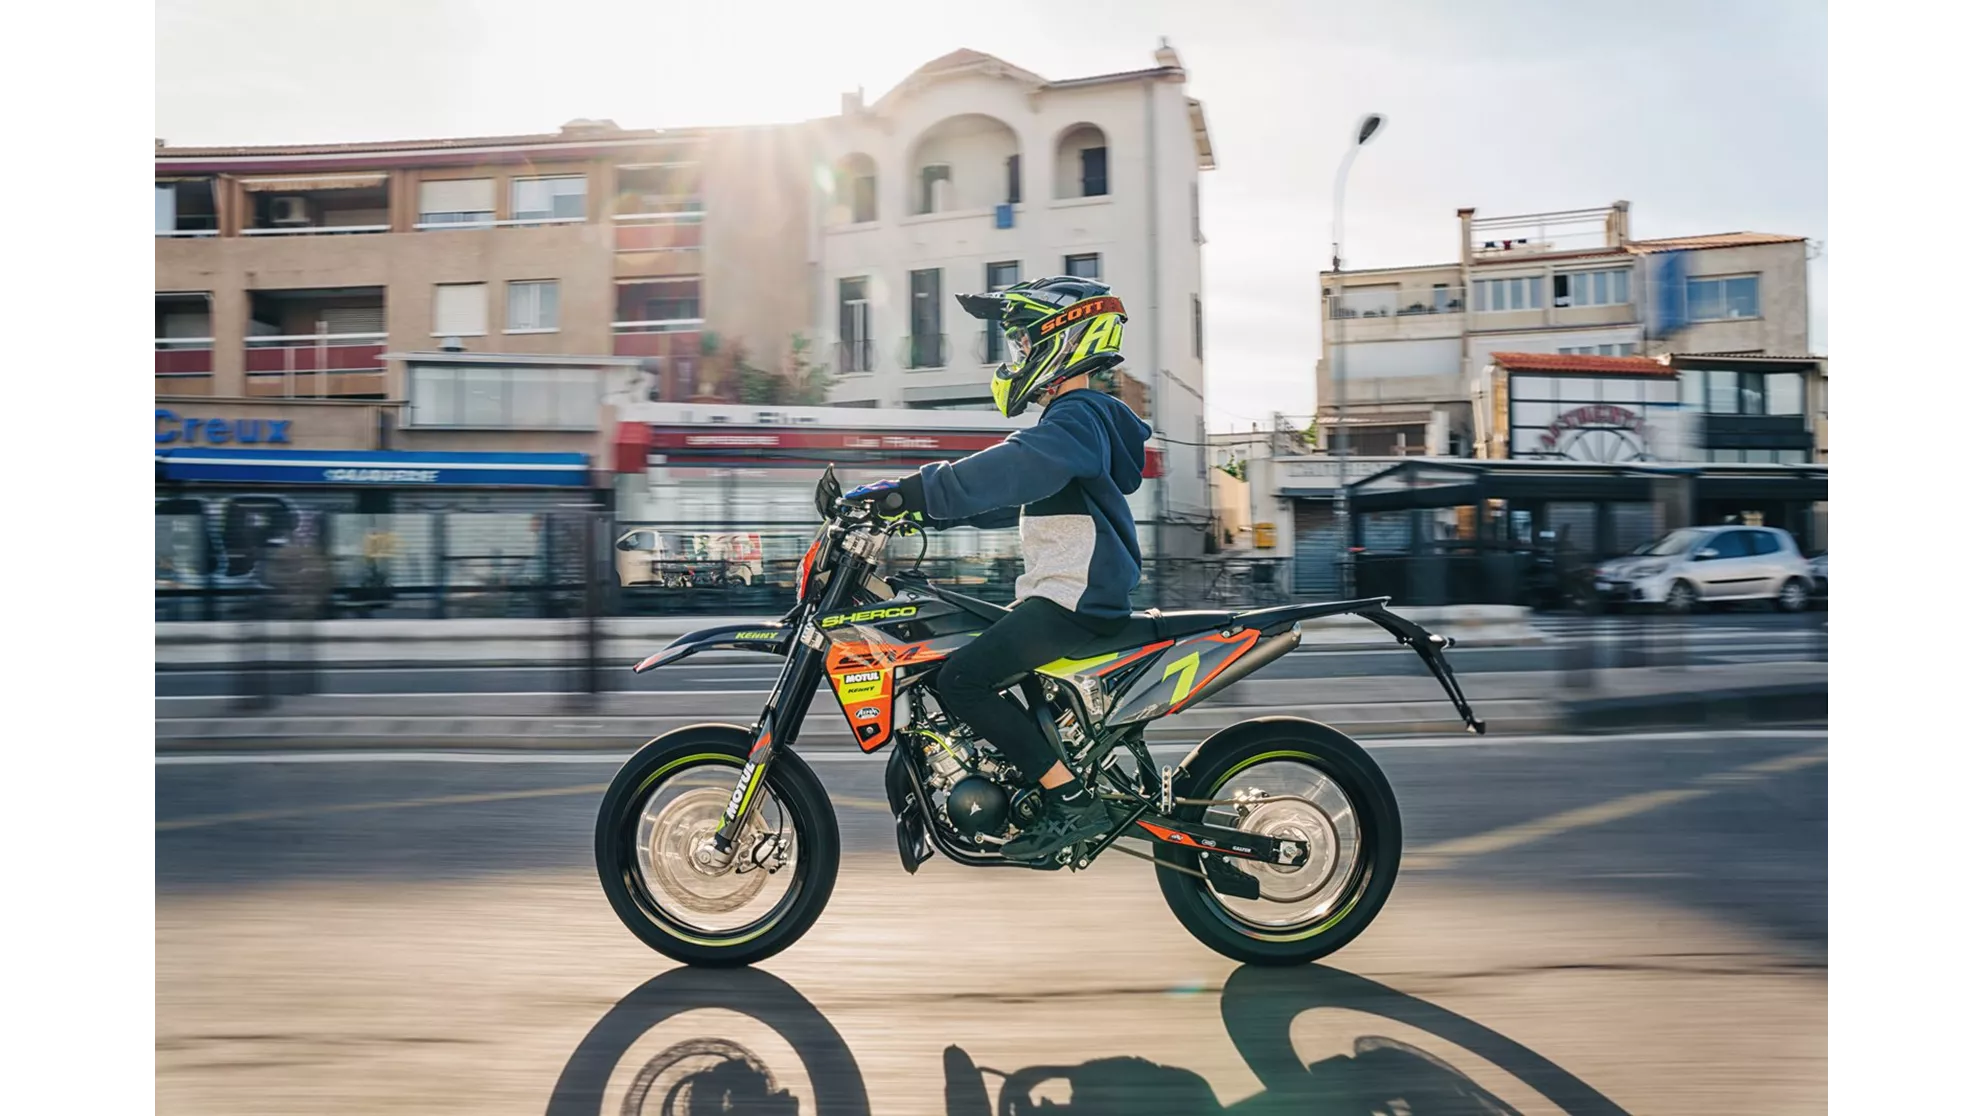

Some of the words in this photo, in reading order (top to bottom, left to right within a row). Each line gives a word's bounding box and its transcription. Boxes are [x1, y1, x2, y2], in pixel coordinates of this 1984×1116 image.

[1041, 300, 1104, 336] SCOTT
[154, 408, 294, 443] Creux
[821, 606, 917, 628] SHERCO
[735, 631, 779, 640] KENNY
[845, 672, 879, 684] MOTUL
[1161, 651, 1200, 706] 7
[726, 762, 756, 821] MOTUL
